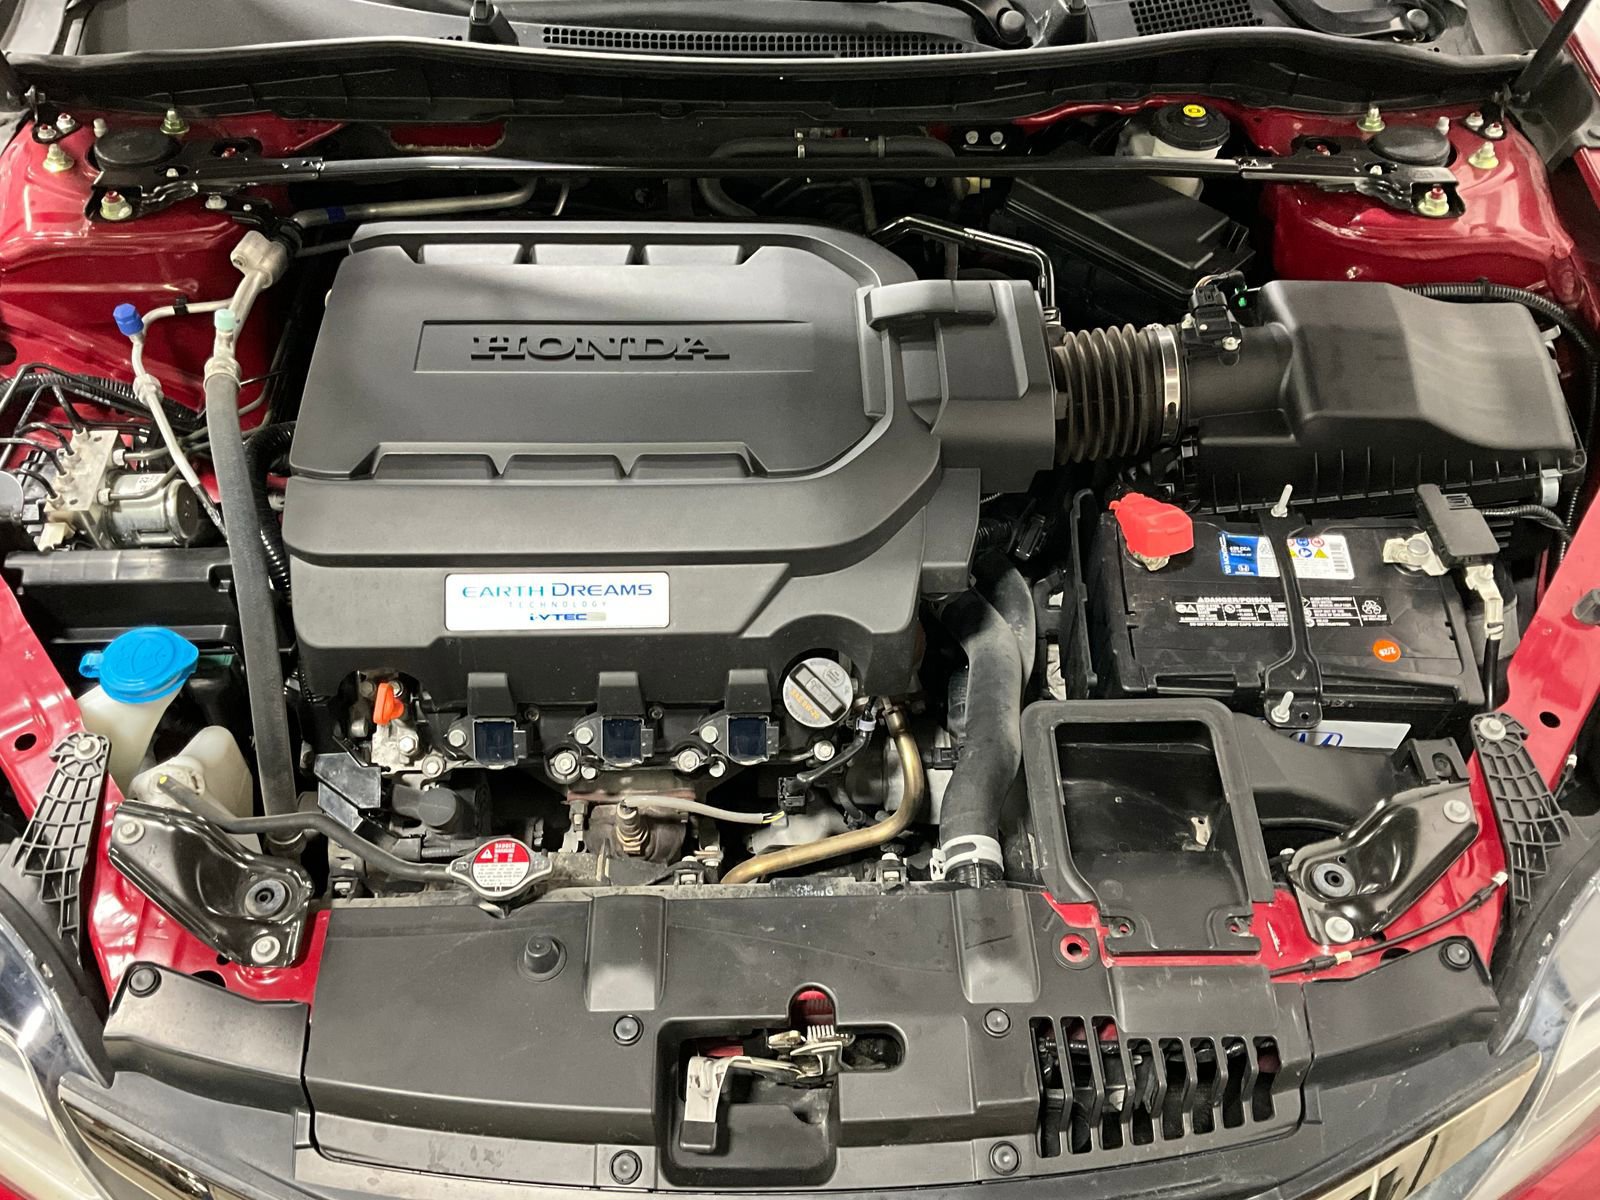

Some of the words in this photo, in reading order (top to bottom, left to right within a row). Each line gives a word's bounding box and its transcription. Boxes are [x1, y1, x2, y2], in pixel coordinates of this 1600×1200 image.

[471, 336, 730, 361] HONDA
[462, 585, 544, 598] EARTH
[552, 582, 652, 597] DREAMS
